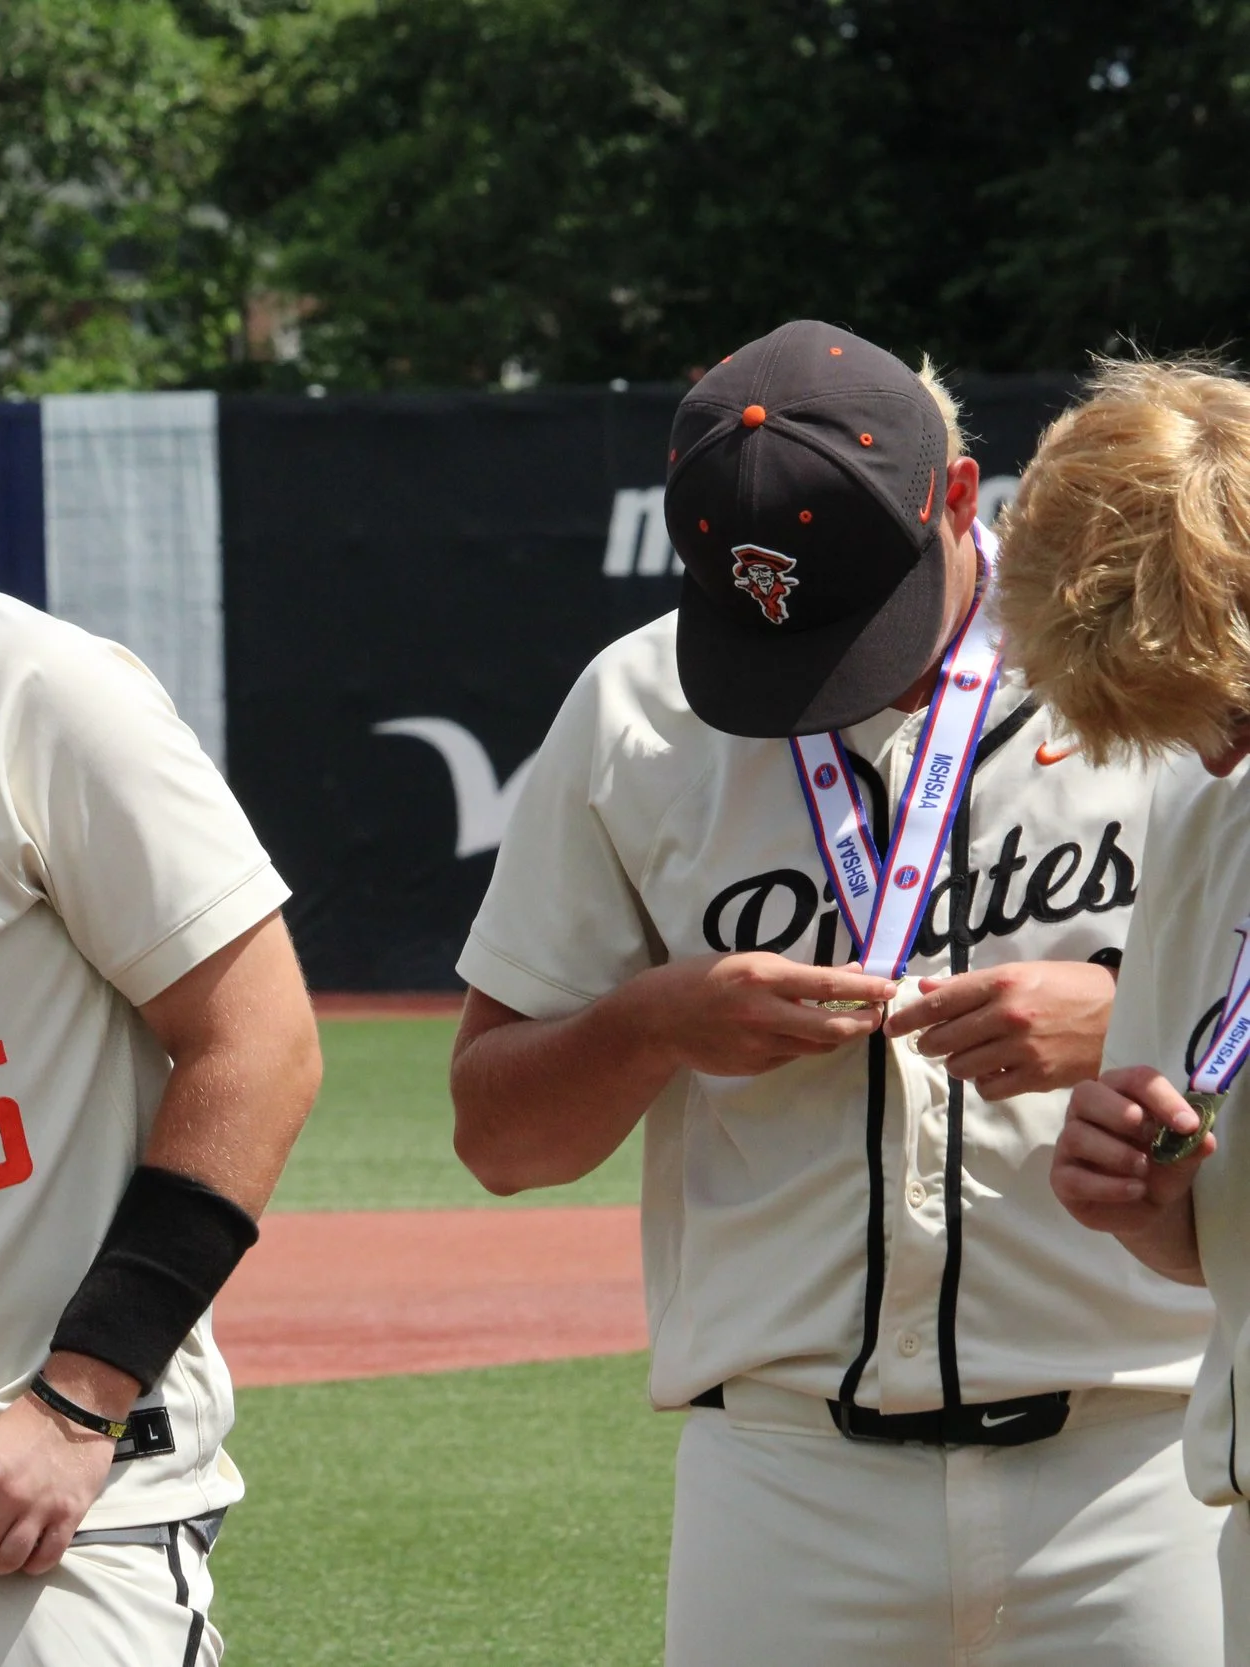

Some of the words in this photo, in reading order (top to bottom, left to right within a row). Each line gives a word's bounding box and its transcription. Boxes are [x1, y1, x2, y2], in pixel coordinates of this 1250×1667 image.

[918, 753, 953, 809] MSHSAA
[702, 821, 1137, 965] Piates
[836, 835, 869, 898] MSHSAA
[1206, 1016, 1250, 1075] MSHSAA
[148, 1424, 159, 1440] L
